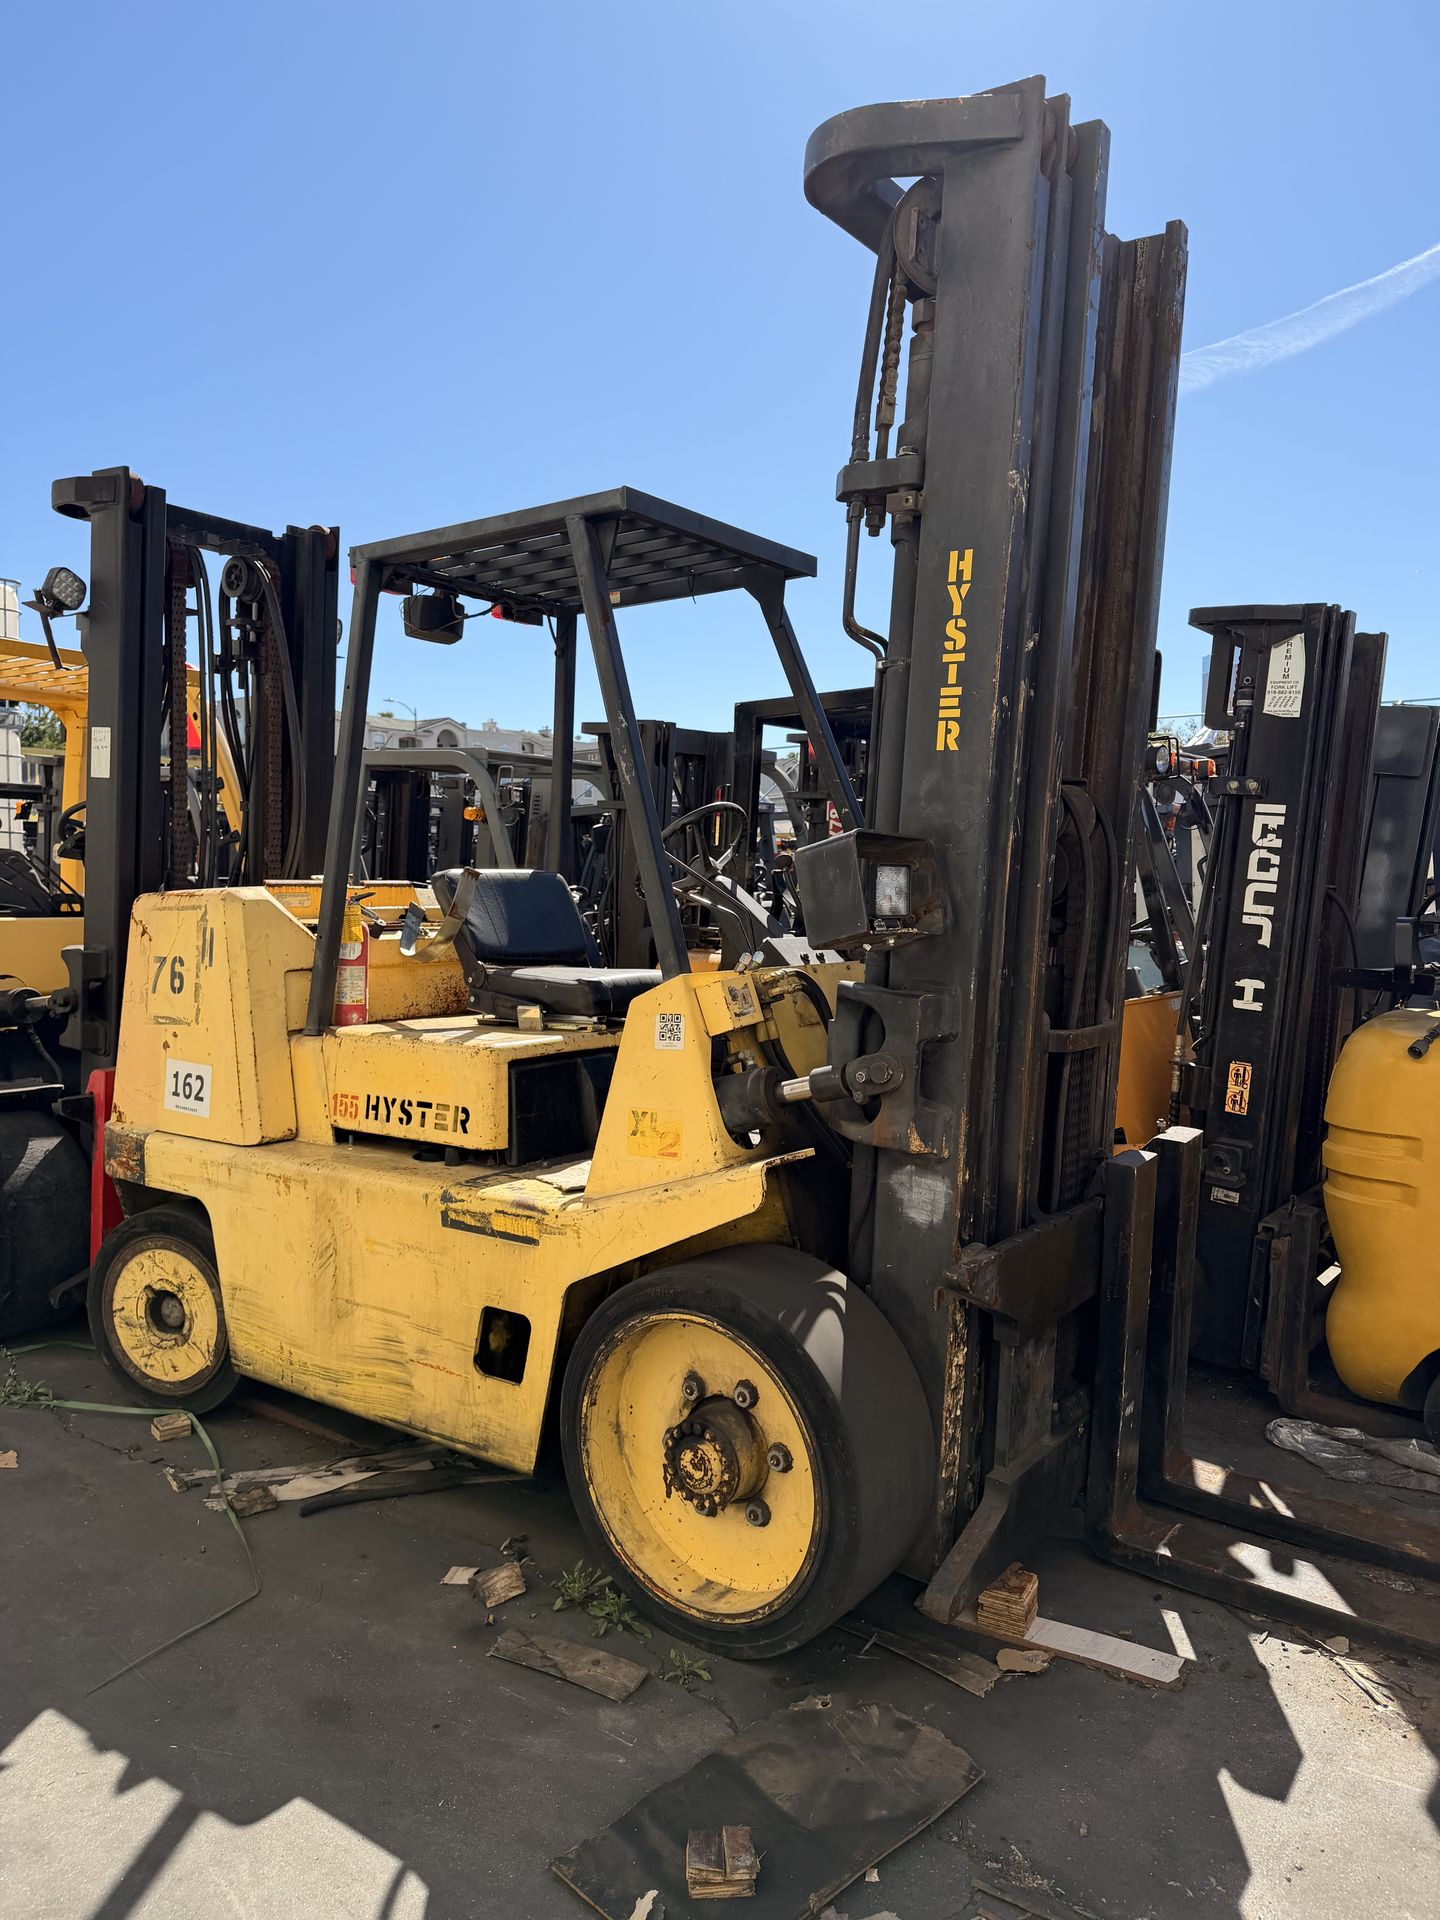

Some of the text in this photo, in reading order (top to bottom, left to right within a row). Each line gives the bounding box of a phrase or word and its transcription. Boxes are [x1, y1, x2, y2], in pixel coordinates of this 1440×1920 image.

[936, 548, 974, 751] HYSTER
[150, 955, 185, 995] 76
[171, 1070, 205, 1103] 162
[332, 1092, 471, 1135] 155 HYSTER
